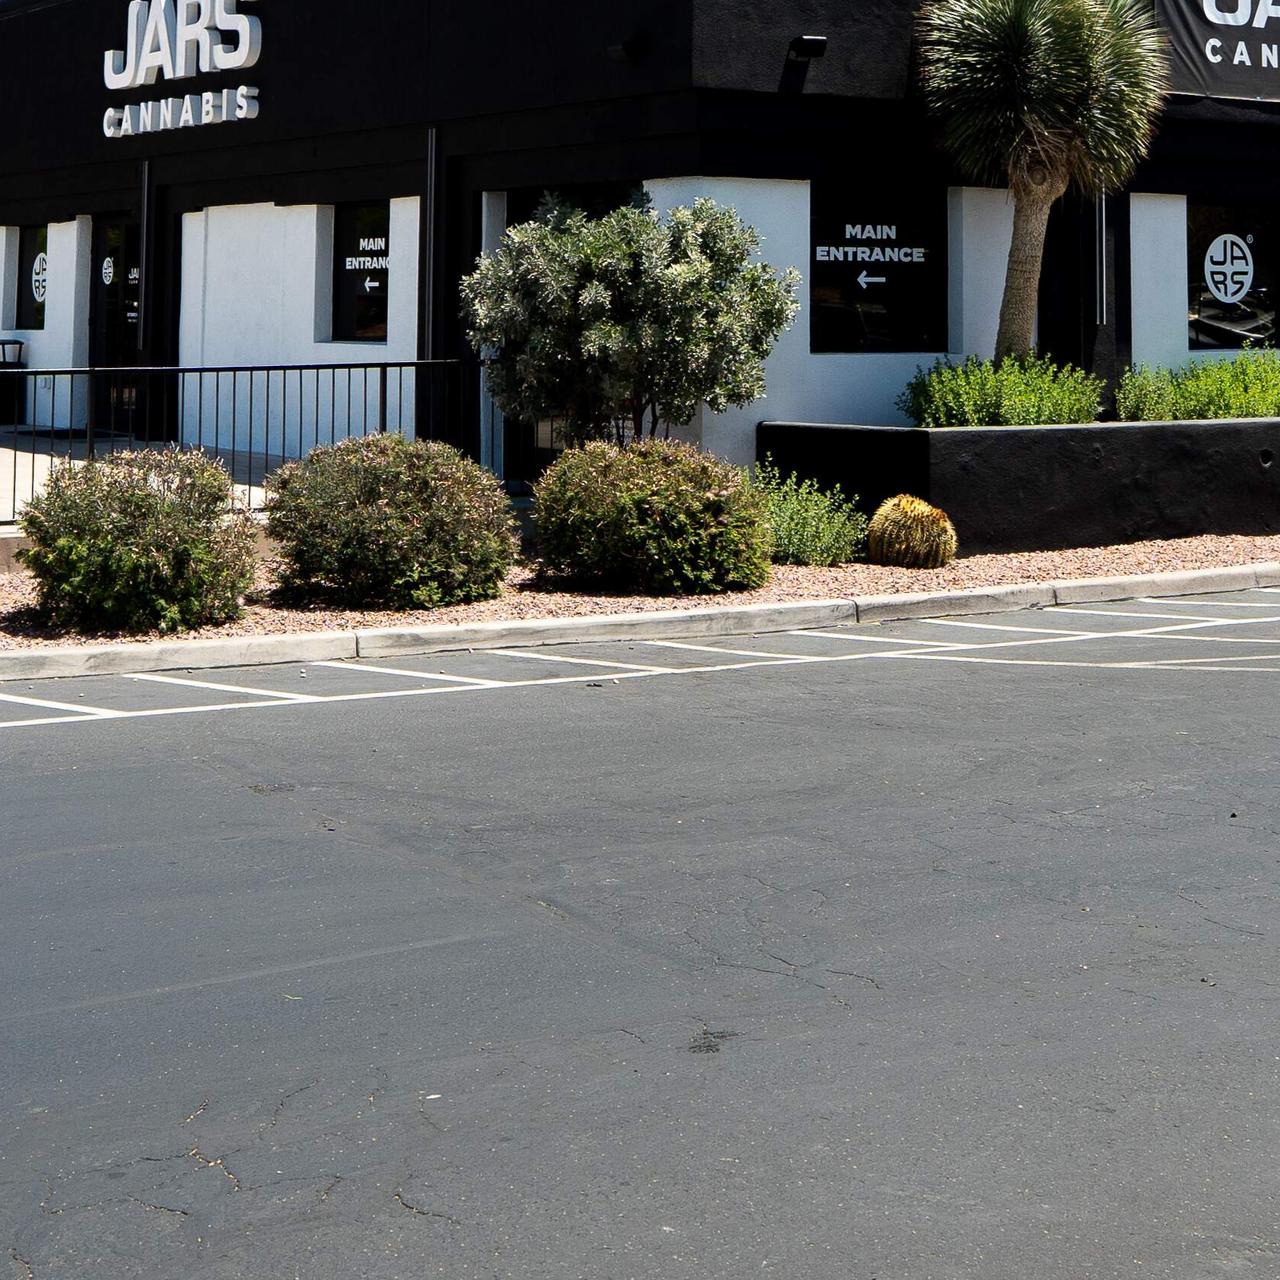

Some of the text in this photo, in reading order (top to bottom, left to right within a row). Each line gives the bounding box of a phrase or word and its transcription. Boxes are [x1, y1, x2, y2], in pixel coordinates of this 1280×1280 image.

[103, 84, 259, 138] CANNABIS
[845, 224, 897, 239] MAIN
[359, 237, 386, 251] MAIN
[816, 246, 925, 262] ENTRANCE
[1210, 239, 1249, 267] JA
[1210, 271, 1249, 297] RS
